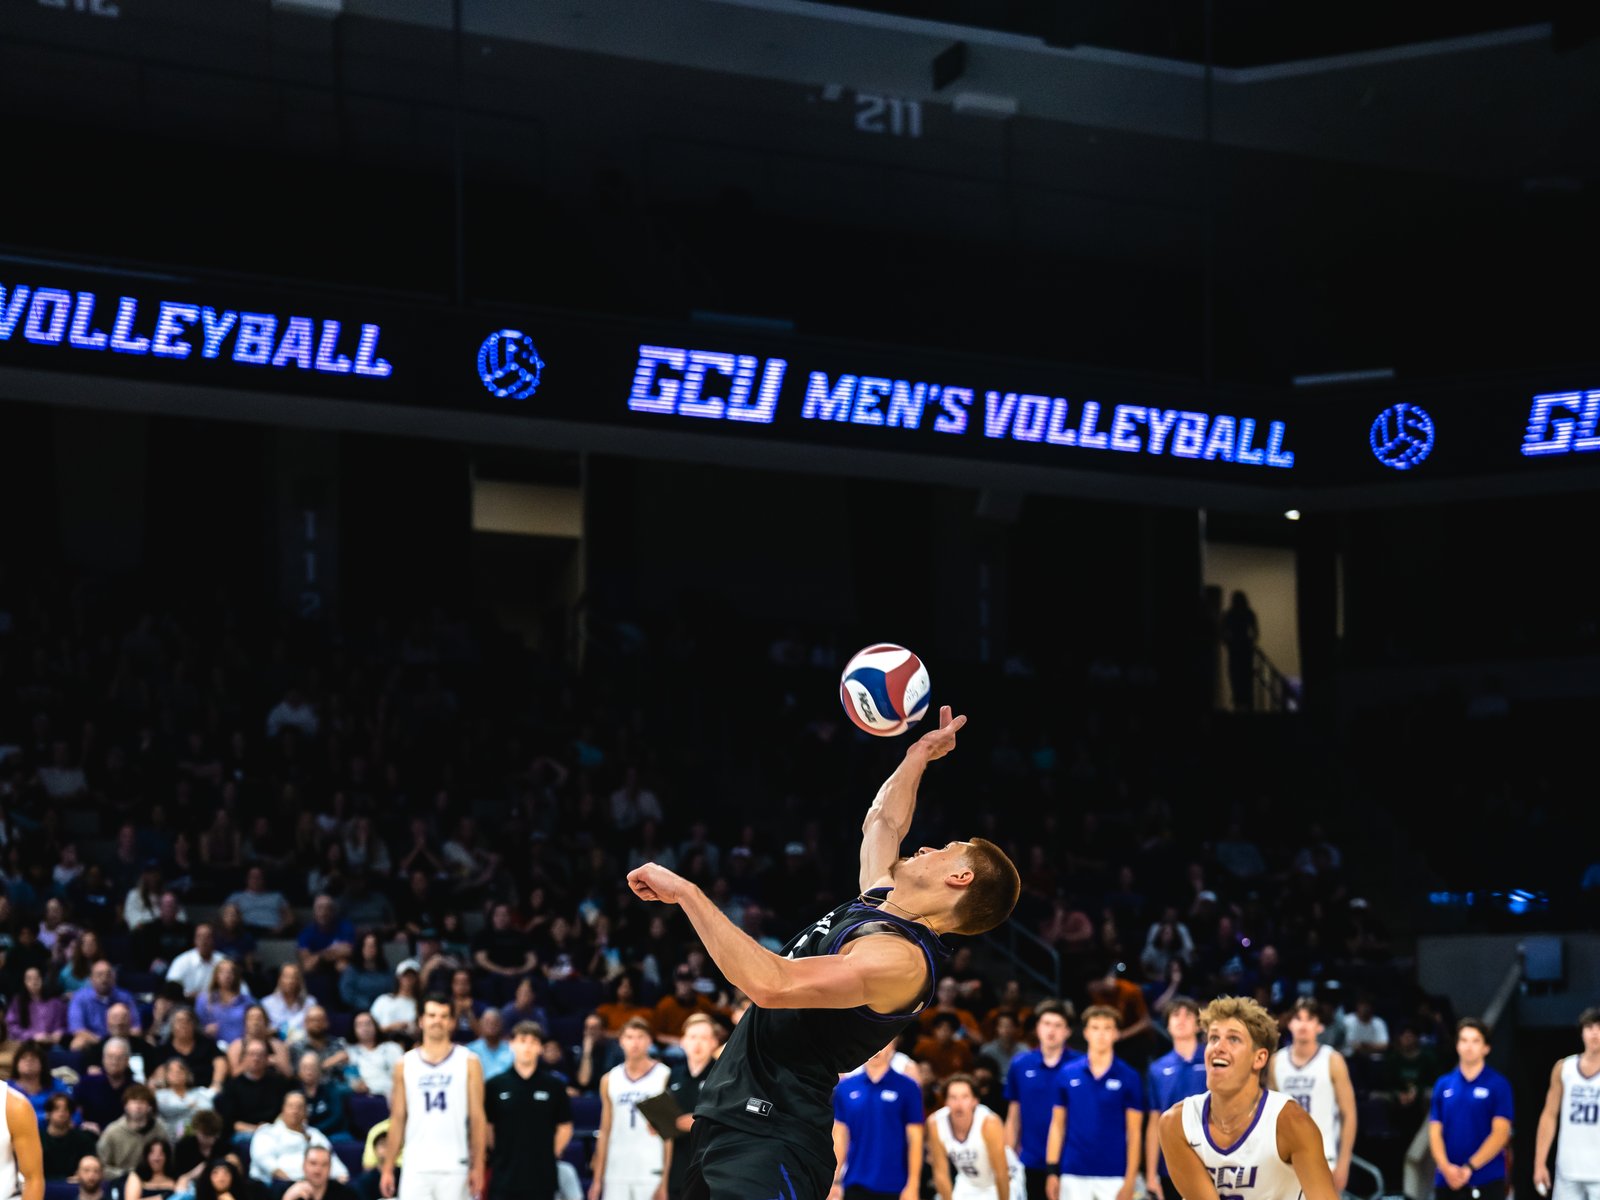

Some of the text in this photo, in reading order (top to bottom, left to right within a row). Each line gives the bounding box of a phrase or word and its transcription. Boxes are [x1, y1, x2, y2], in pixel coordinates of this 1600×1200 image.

[855, 94, 922, 138] 211
[0, 283, 393, 378] VOLLEYBALL
[627, 344, 1294, 468] GCU MEN'S VOLLEYBALL
[424, 1090, 447, 1113] 14
[1569, 1103, 1599, 1125] 20
